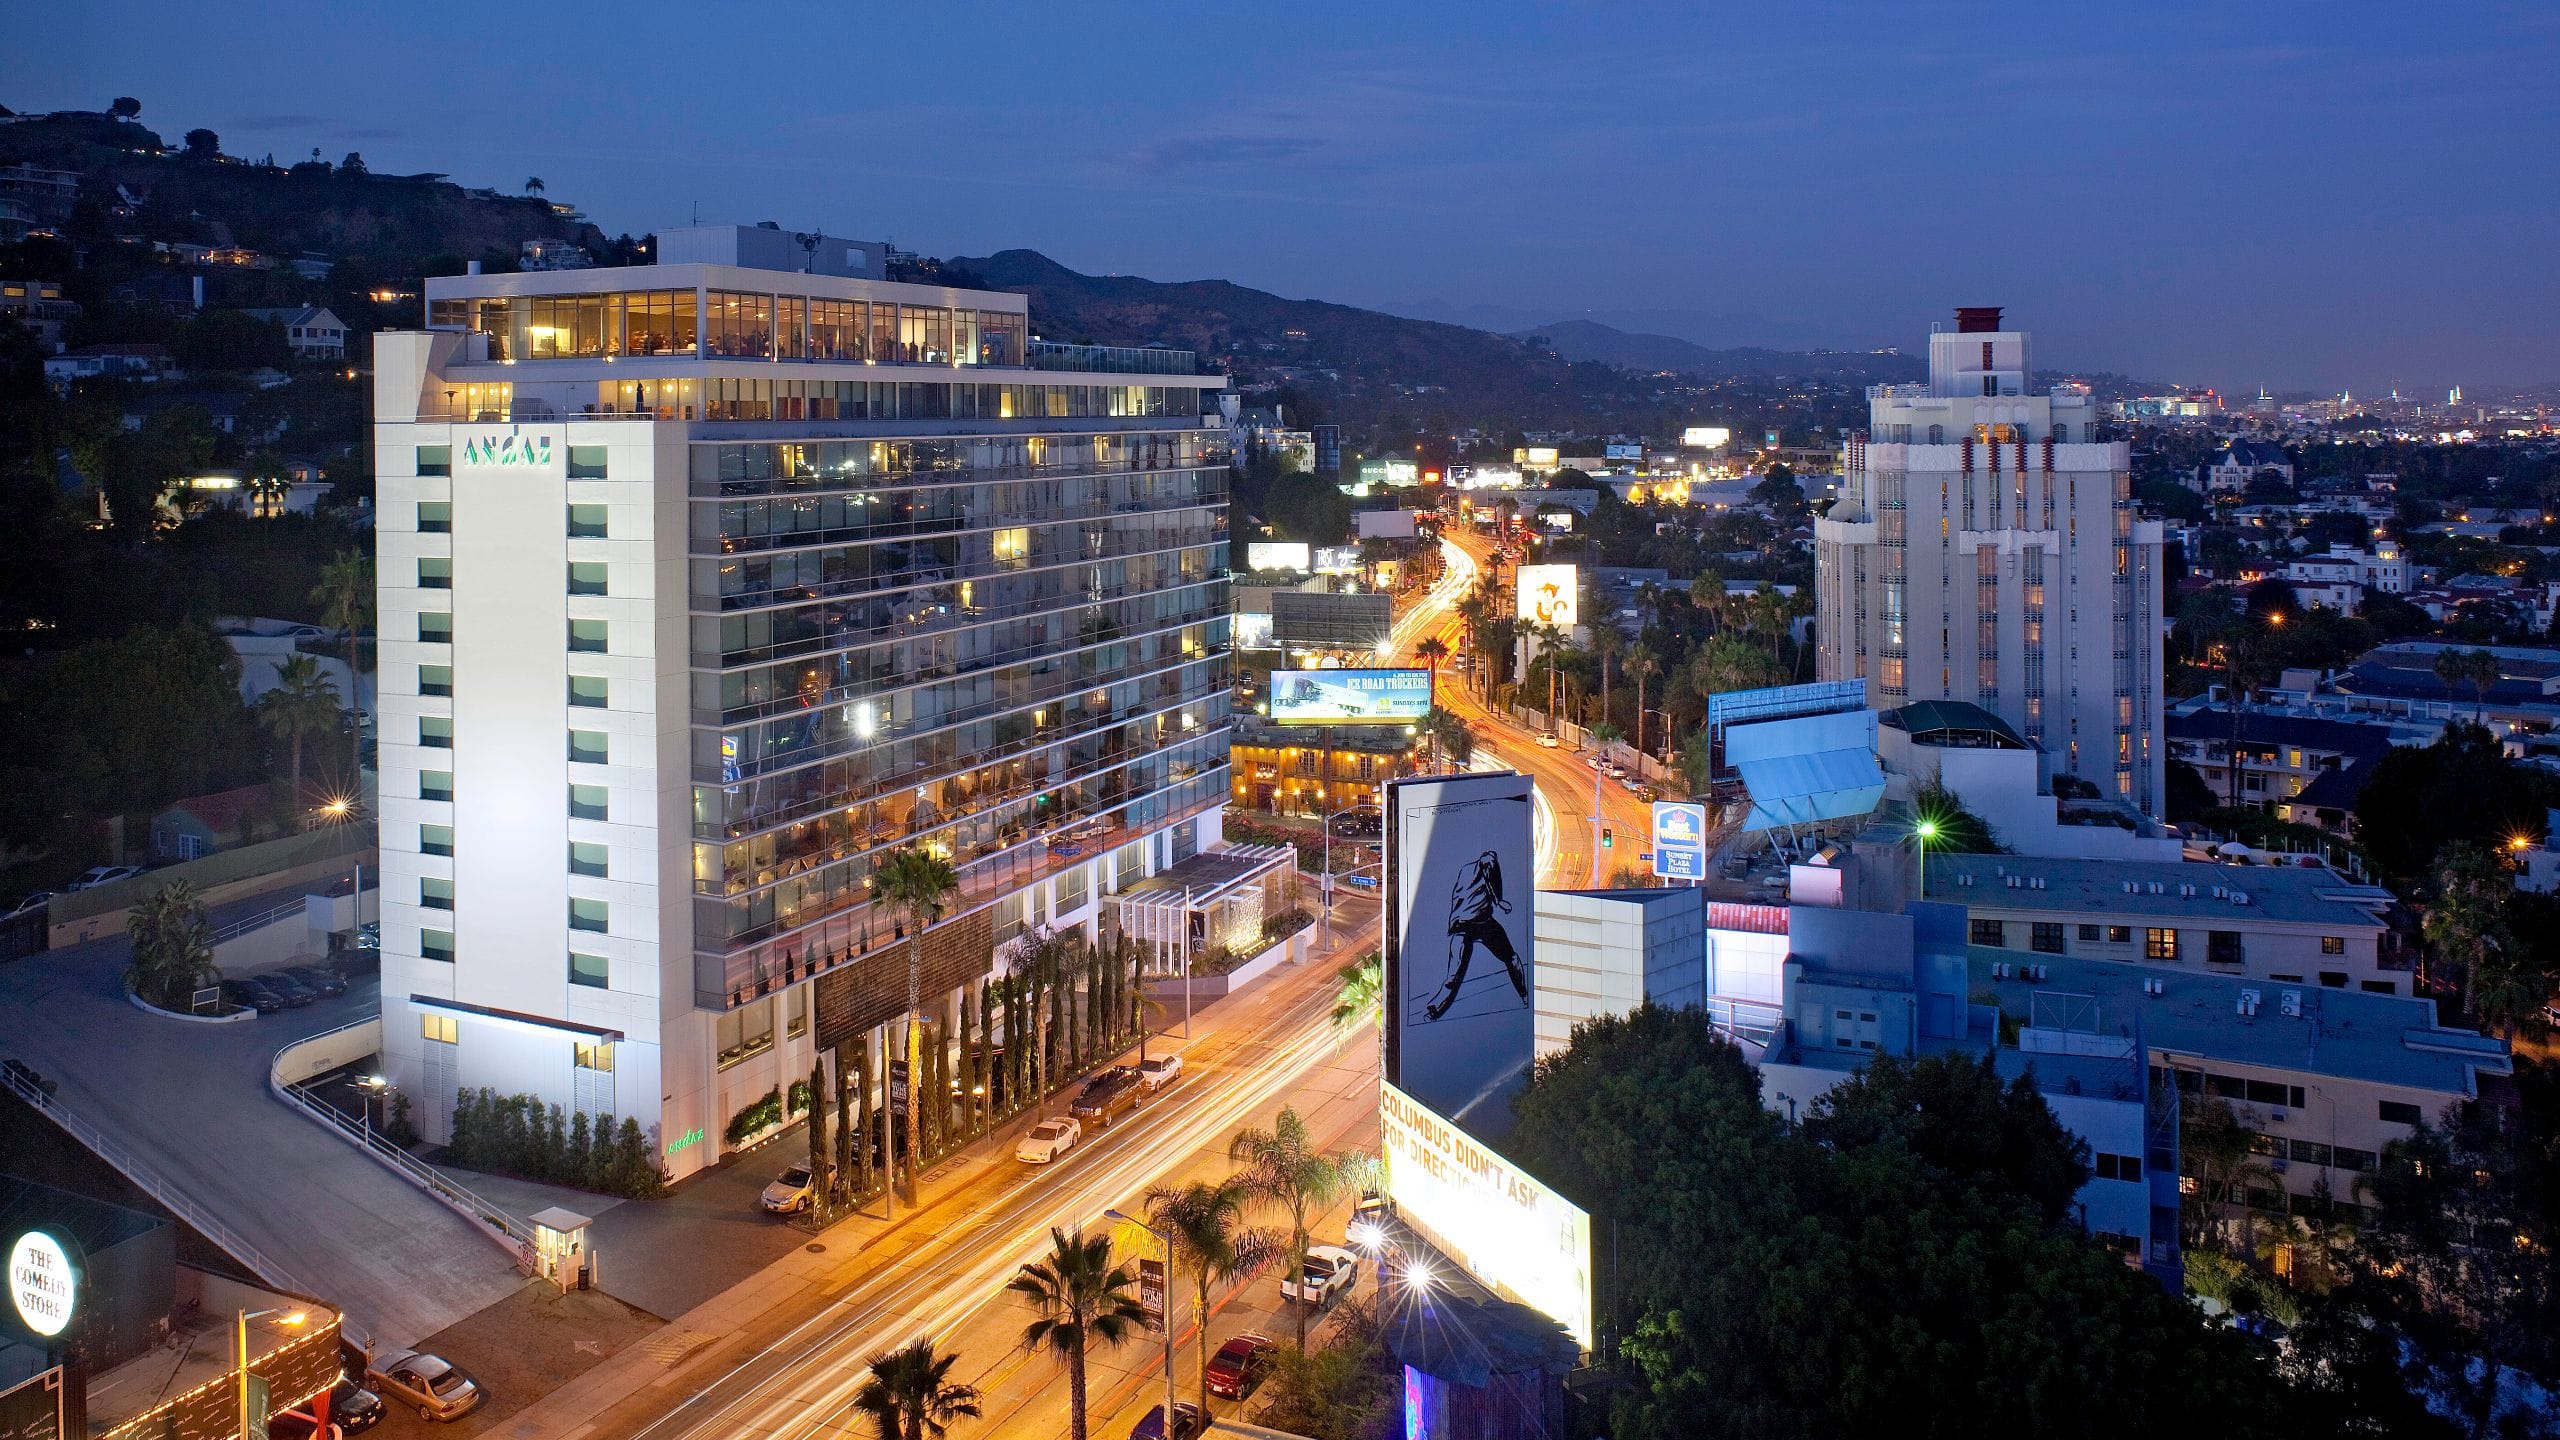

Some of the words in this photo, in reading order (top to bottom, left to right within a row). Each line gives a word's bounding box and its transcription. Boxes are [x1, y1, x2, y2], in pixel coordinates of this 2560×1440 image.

[1347, 678, 1361, 690] ICE
[1362, 678, 1384, 690] ROAD
[1386, 678, 1428, 690] TRUCKERS
[1660, 828, 1698, 841] Western
[1382, 1090, 1450, 1154] COLUMBUS
[1455, 1139, 1503, 1190] DIDN'T
[1508, 1176, 1540, 1211] ASK
[1383, 1118, 1405, 1153] FOR
[1410, 1138, 1488, 1197] DIRECTION
[29, 1247, 53, 1271] THE
[15, 1266, 66, 1297] COMEDY
[22, 1291, 62, 1319] STORE
